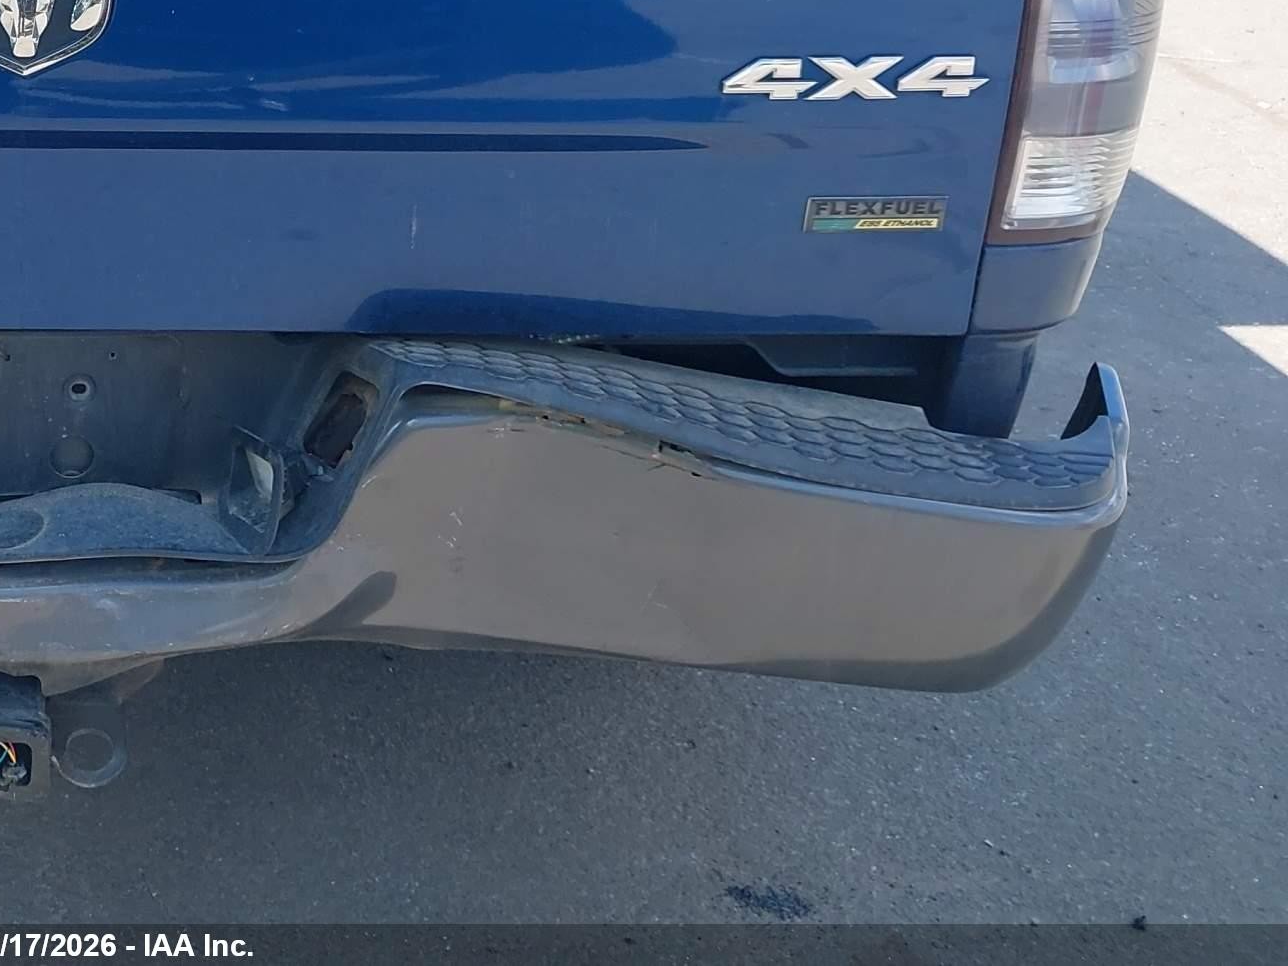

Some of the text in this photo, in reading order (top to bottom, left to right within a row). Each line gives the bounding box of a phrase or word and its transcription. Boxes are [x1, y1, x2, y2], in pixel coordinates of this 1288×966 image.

[721, 55, 990, 100] 4X4
[815, 201, 941, 216] FLEXFUEL
[883, 219, 935, 228] ETHANOL
